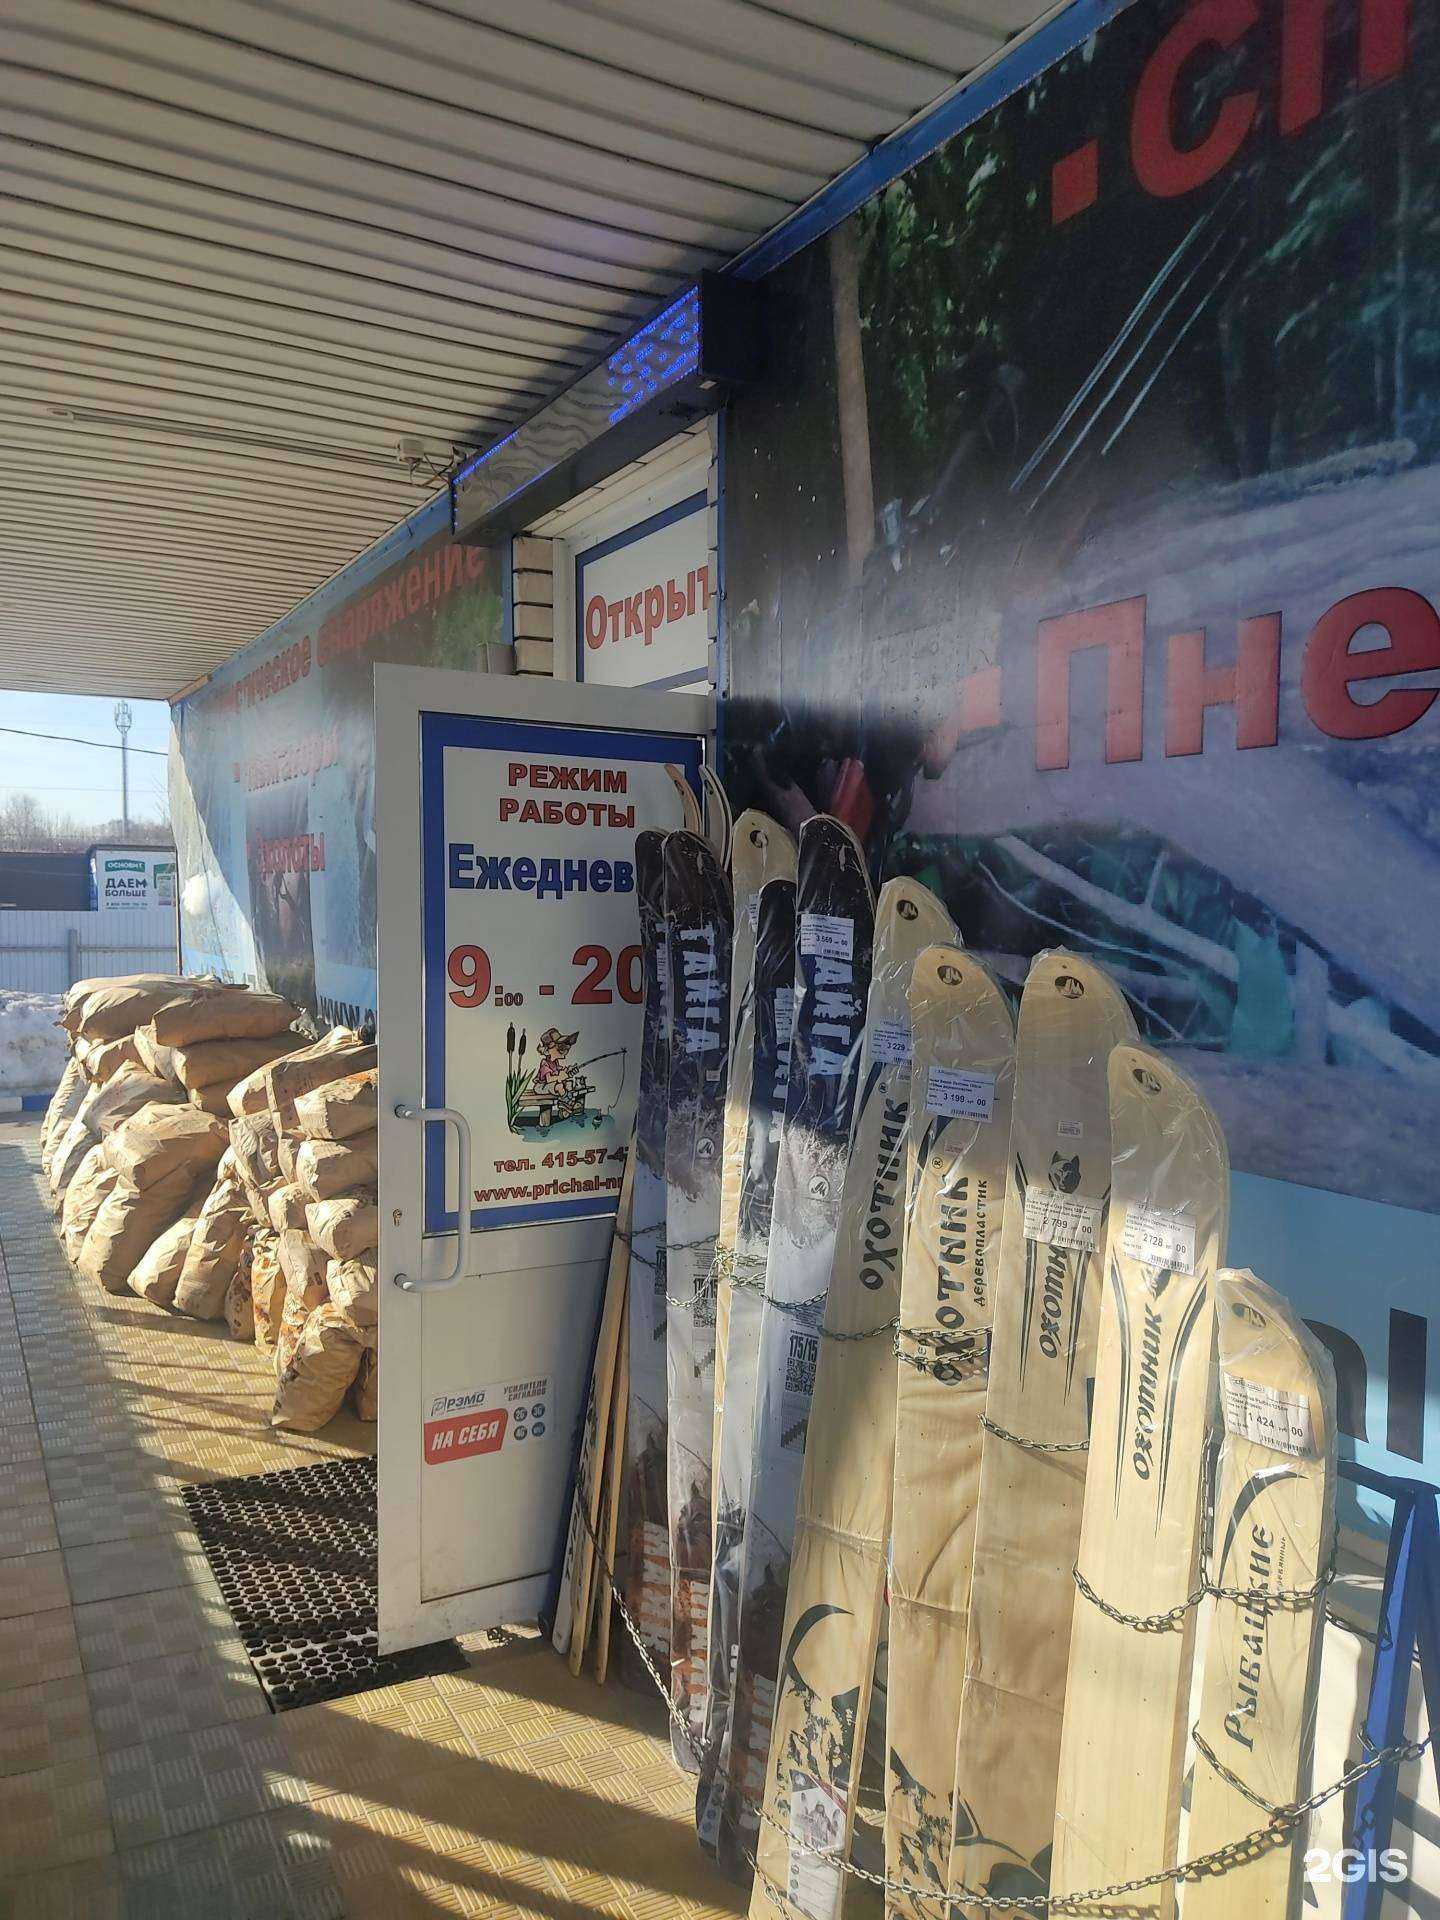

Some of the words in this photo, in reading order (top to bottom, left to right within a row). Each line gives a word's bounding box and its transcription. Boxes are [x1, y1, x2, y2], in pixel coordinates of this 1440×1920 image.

[508, 763, 627, 794] РЕЖИМ
[499, 798, 635, 828] РАБОТЫ
[105, 878, 148, 889] ДАЕМ
[448, 842, 635, 900] Ежеднев
[105, 889, 147, 897] БОЛЬШЕ
[679, 920, 728, 1053] ТАЙГА
[808, 955, 863, 1077] АЙГА
[493, 1158, 536, 1174] тел.
[1081, 1225, 1092, 1235] 00
[1176, 1242, 1187, 1254] 00
[788, 1334, 819, 1363] 175/15
[431, 1428, 454, 1451] НА
[457, 1420, 500, 1446] СЕБЯ
[1291, 1426, 1304, 1438] 00
